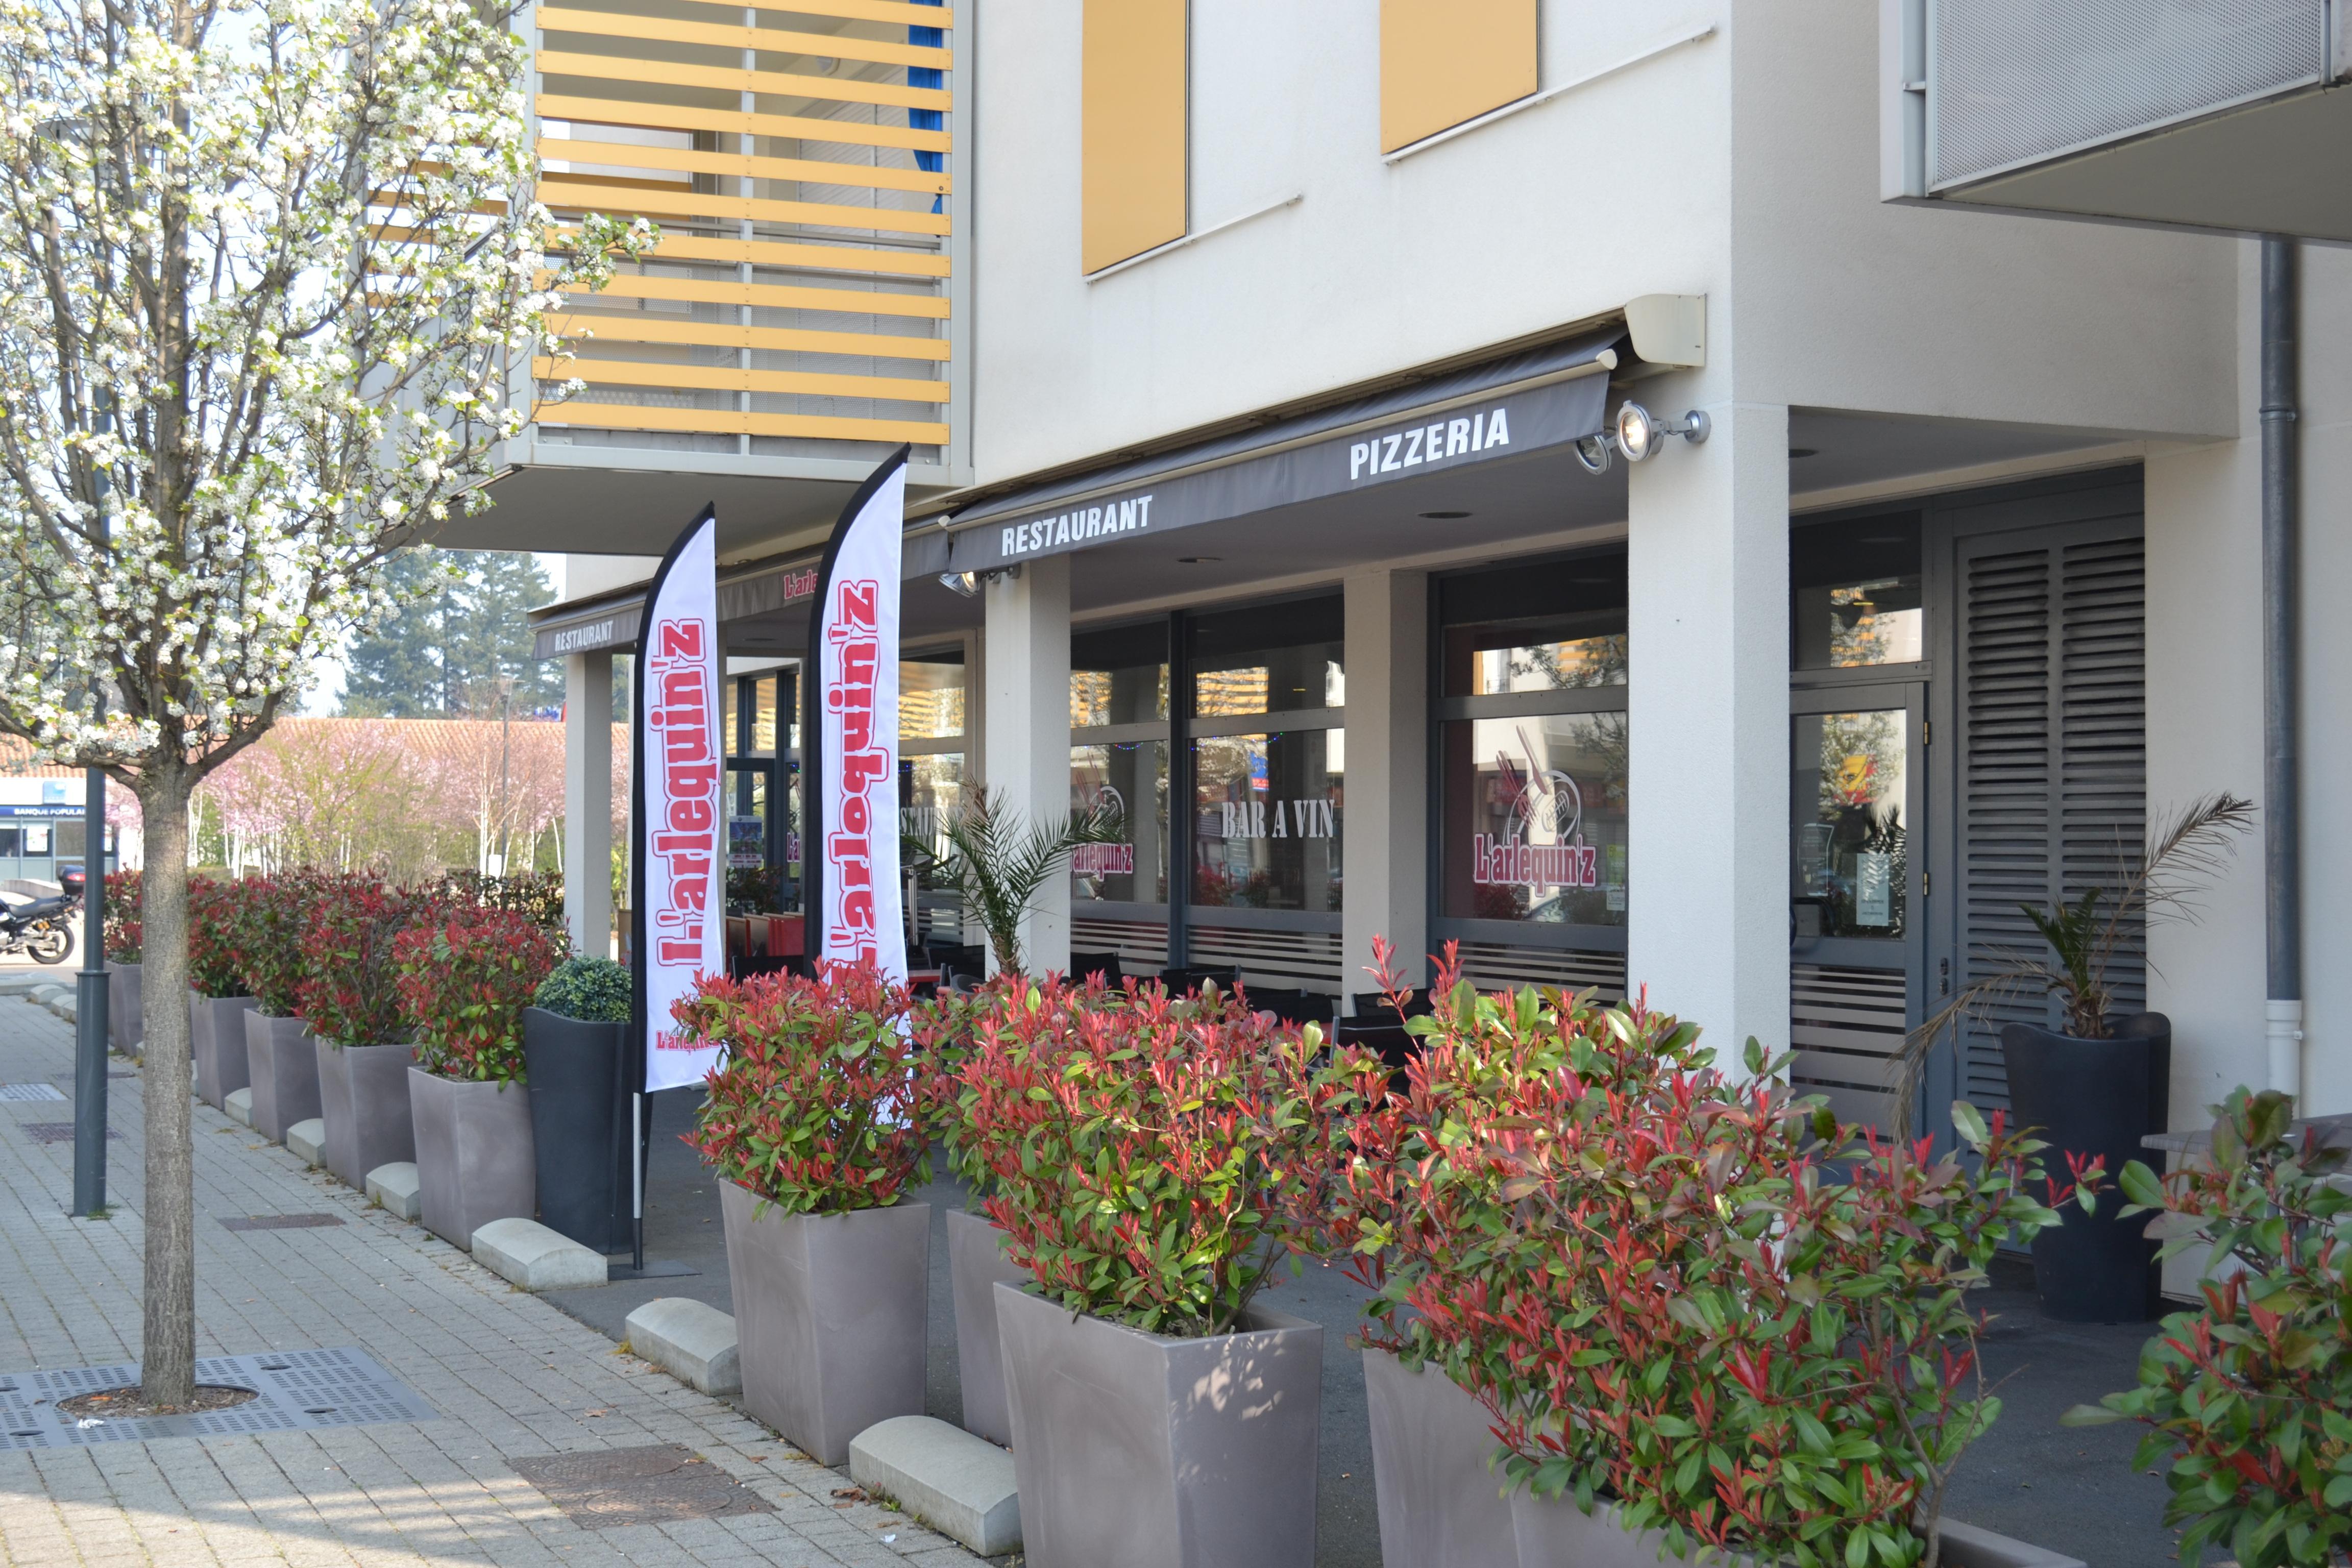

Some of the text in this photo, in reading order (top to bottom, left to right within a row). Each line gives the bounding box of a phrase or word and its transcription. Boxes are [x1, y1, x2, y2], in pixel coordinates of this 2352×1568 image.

[1001, 408, 1509, 556] RESTAURANT PIZZERIA
[555, 569, 818, 651] RESTAURANT L'arle
[651, 619, 721, 967] L'arlequin'z
[1221, 799, 1335, 838] BAR A VIN
[1475, 834, 1596, 897] L'arlequin'z
